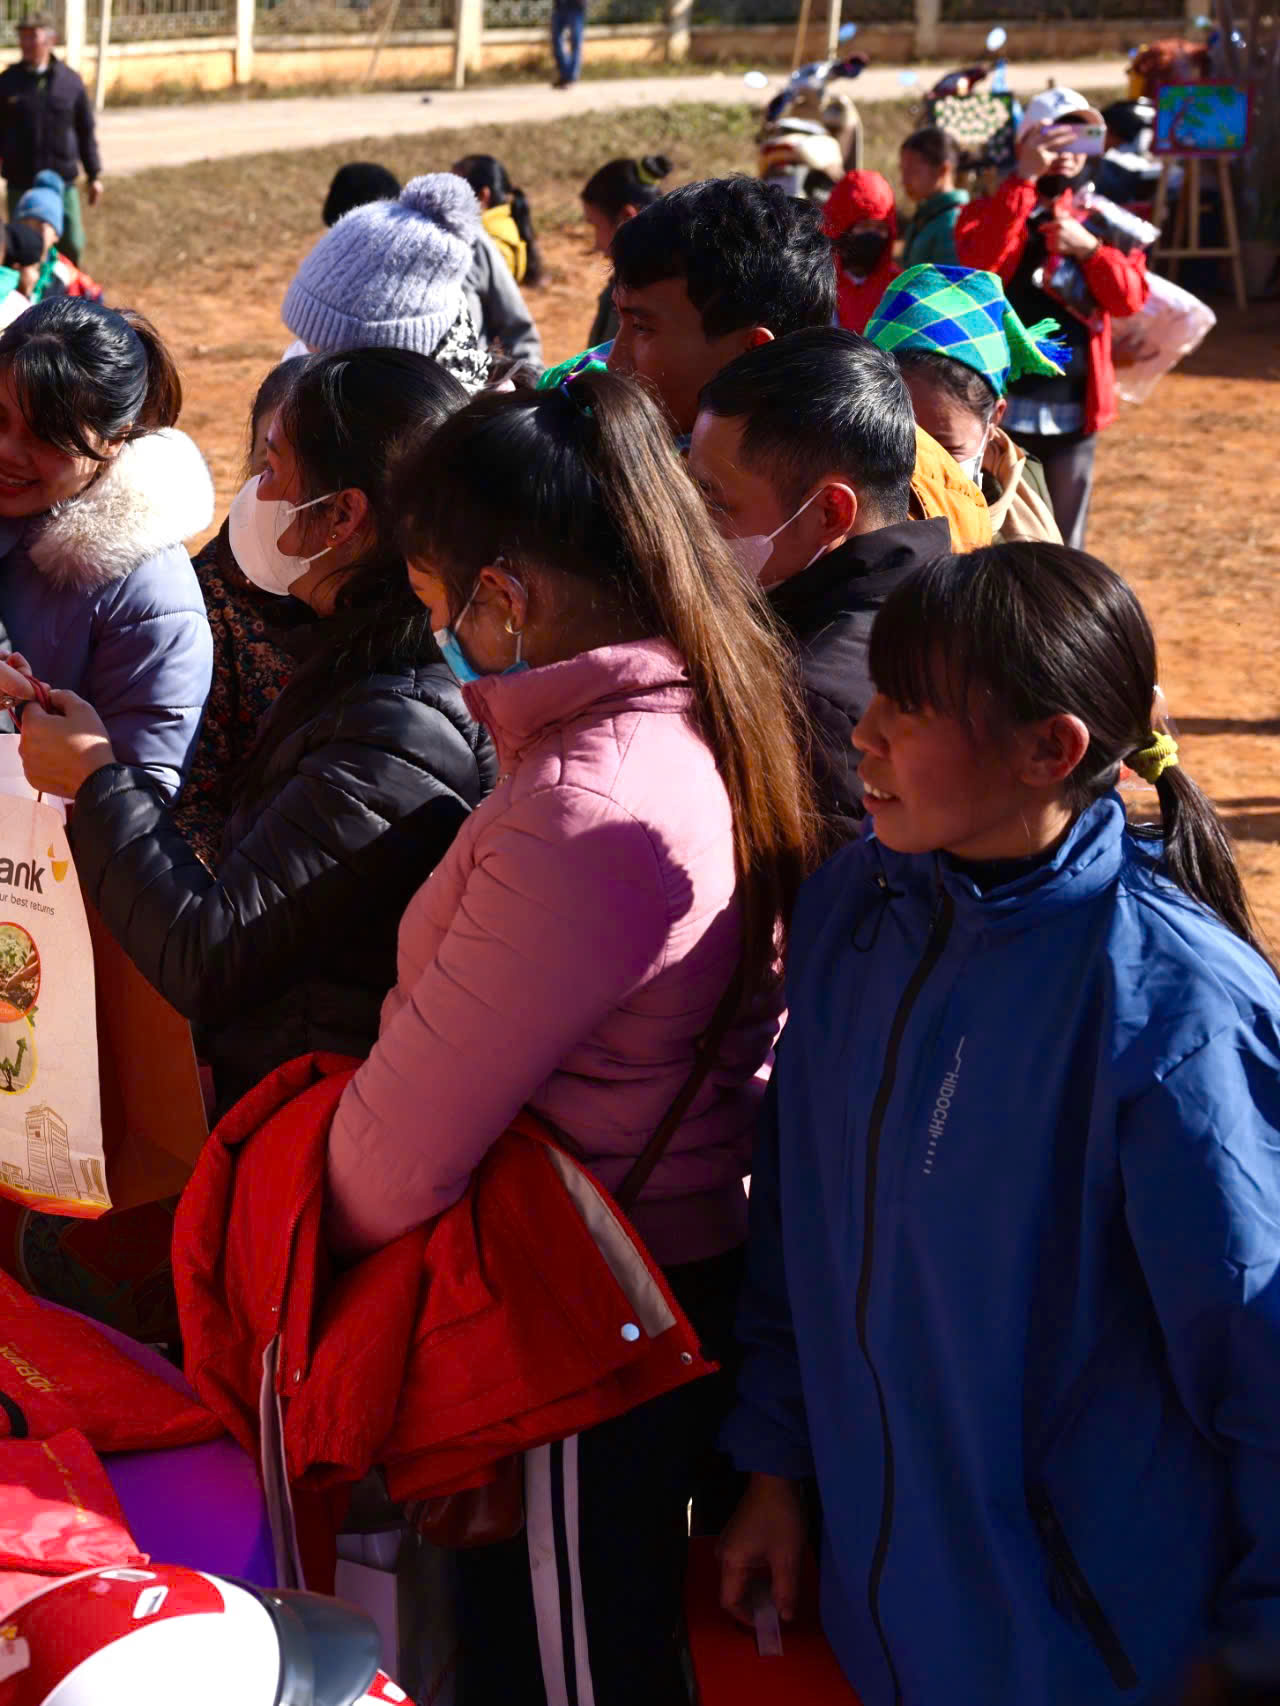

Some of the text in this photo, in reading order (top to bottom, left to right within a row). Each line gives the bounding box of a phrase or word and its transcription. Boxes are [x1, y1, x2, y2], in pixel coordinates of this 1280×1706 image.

[11, 893, 29, 909] best
[29, 900, 55, 916] returns
[927, 1071, 960, 1137] HIDOCHI
